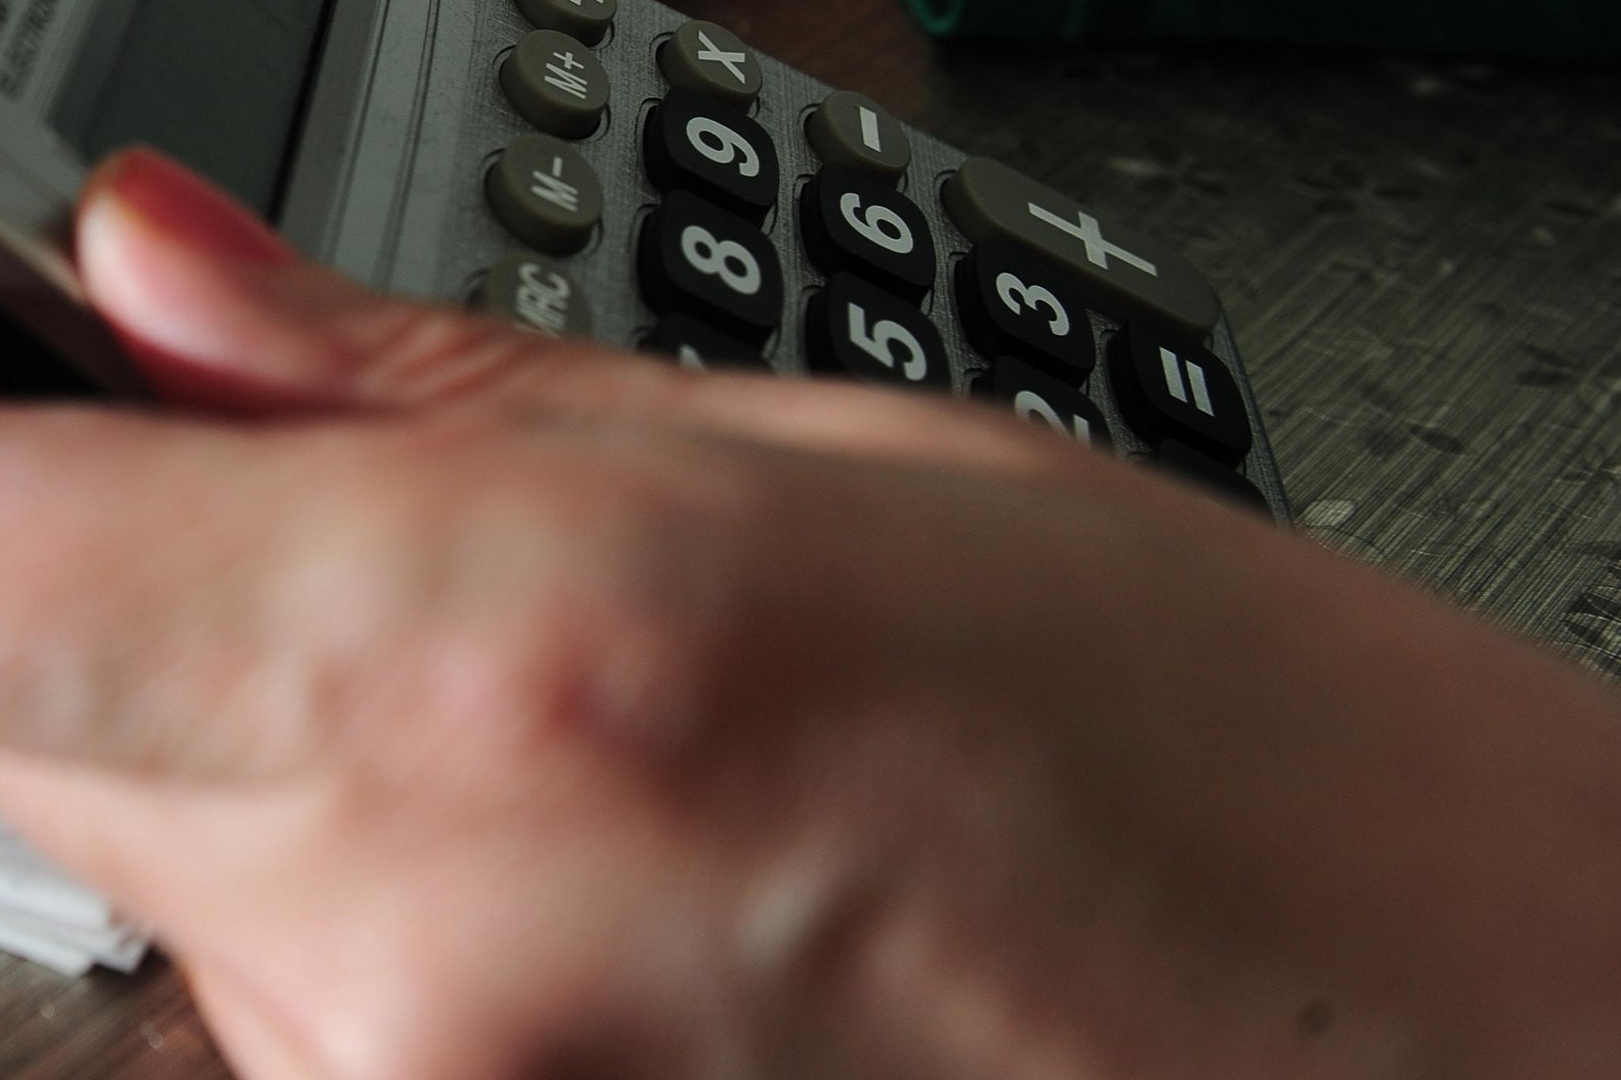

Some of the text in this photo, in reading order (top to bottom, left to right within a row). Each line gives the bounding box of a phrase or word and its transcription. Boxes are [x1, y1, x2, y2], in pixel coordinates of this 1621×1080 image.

[685, 116, 761, 178] 9
[840, 192, 915, 254] 6
[680, 225, 762, 294] 8
[996, 272, 1070, 337] 3
[847, 304, 928, 382] 5
